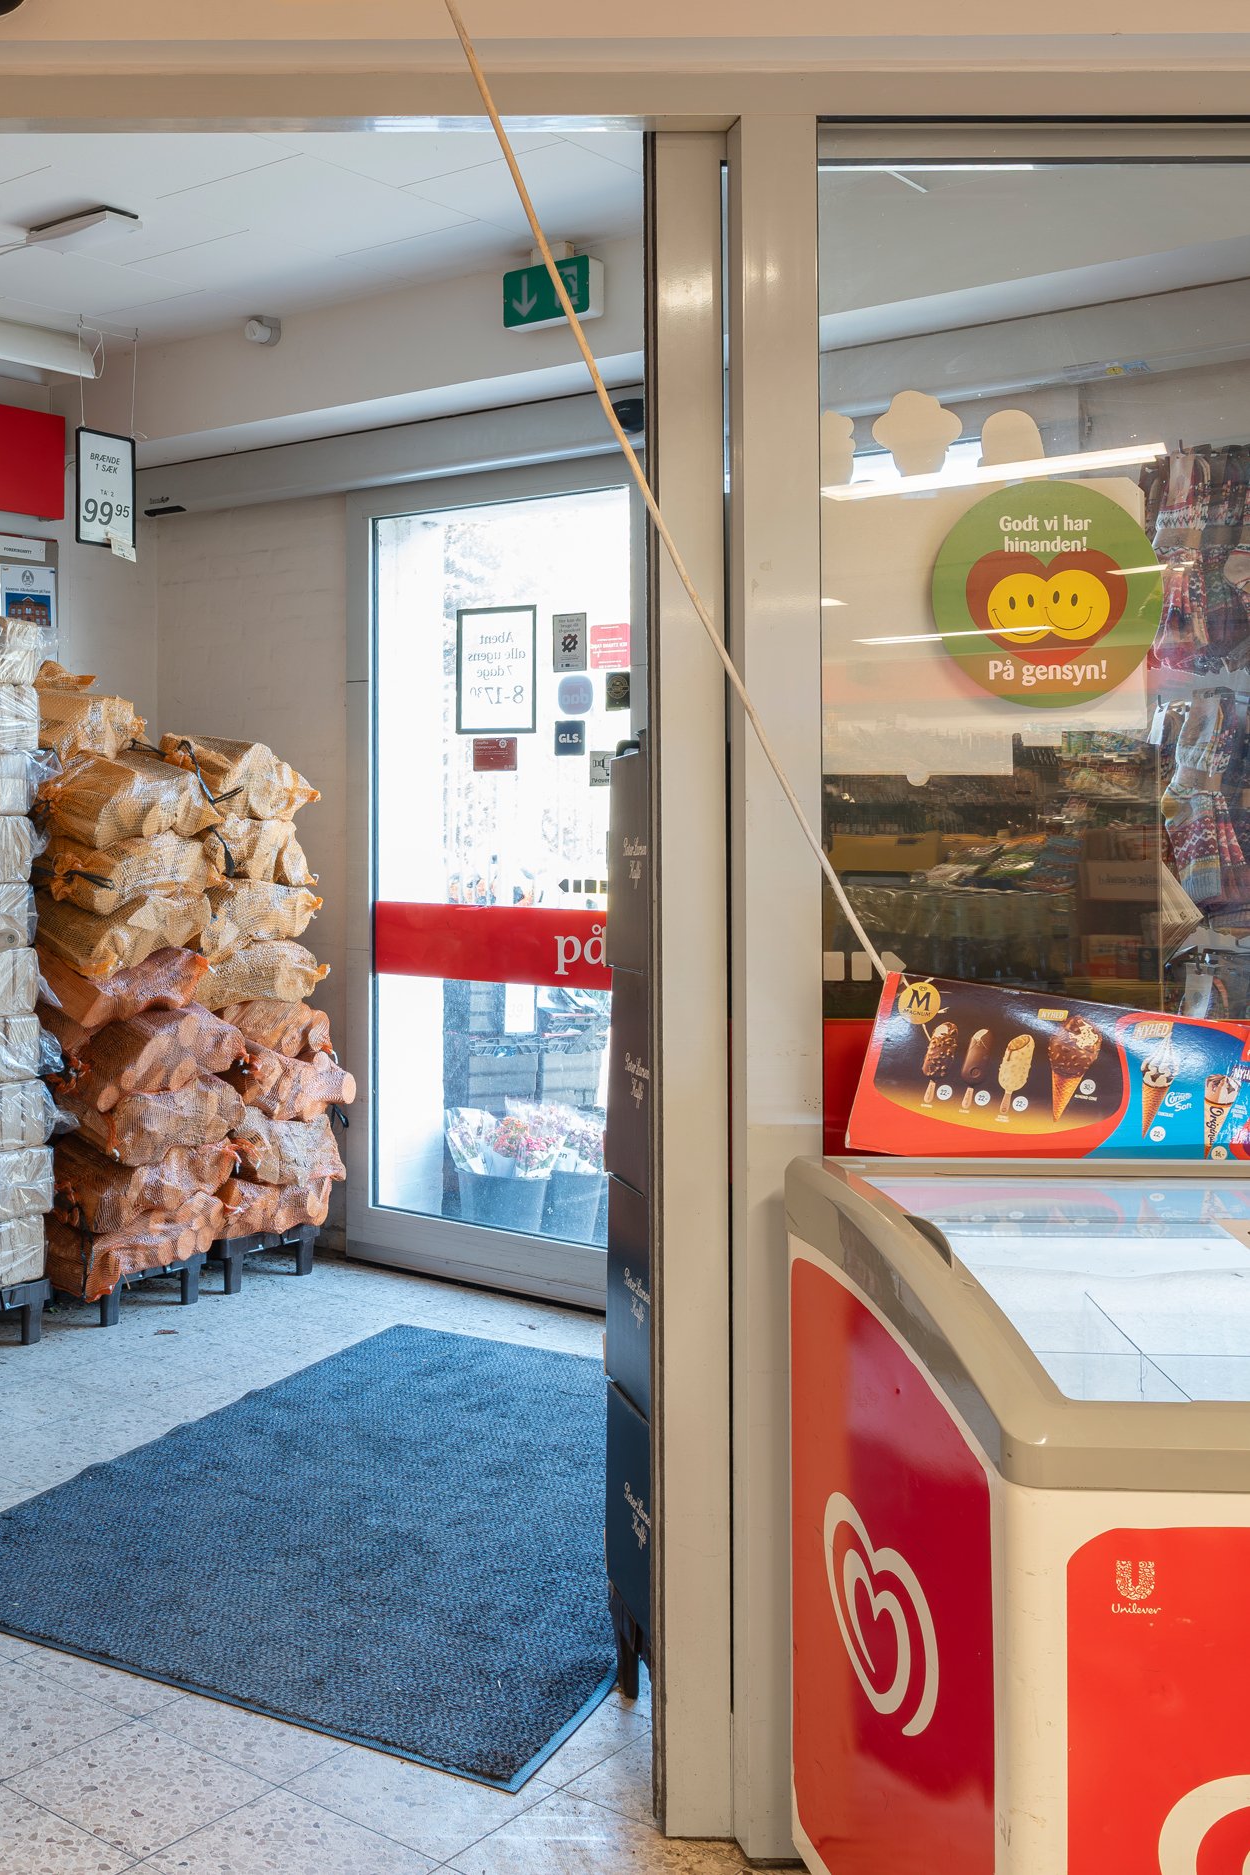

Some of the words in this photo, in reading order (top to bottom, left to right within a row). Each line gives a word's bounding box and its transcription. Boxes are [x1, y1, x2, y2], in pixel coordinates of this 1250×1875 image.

[90, 452, 121, 465] BRÆNDE
[101, 464, 118, 474] SÆK
[82, 498, 114, 526] 99
[114, 504, 130, 518] 95
[999, 515, 1040, 532] Godt
[1044, 515, 1058, 531] vi
[1063, 514, 1092, 531] har
[1004, 536, 1087, 553] hinanden!
[988, 659, 1015, 680] På
[1021, 659, 1107, 687] gensyn!
[591, 777, 610, 785] TV-over
[903, 1008, 931, 1017] MAGNUM
[1041, 1011, 1065, 1019] NYHED
[1136, 1023, 1170, 1037] NYHED
[1232, 1066, 1250, 1080] NYH
[977, 1094, 988, 1102] 22,-
[1015, 1100, 1027, 1108] 22,-
[1174, 1102, 1192, 1112] Soft
[1111, 1603, 1162, 1614] Unilever
